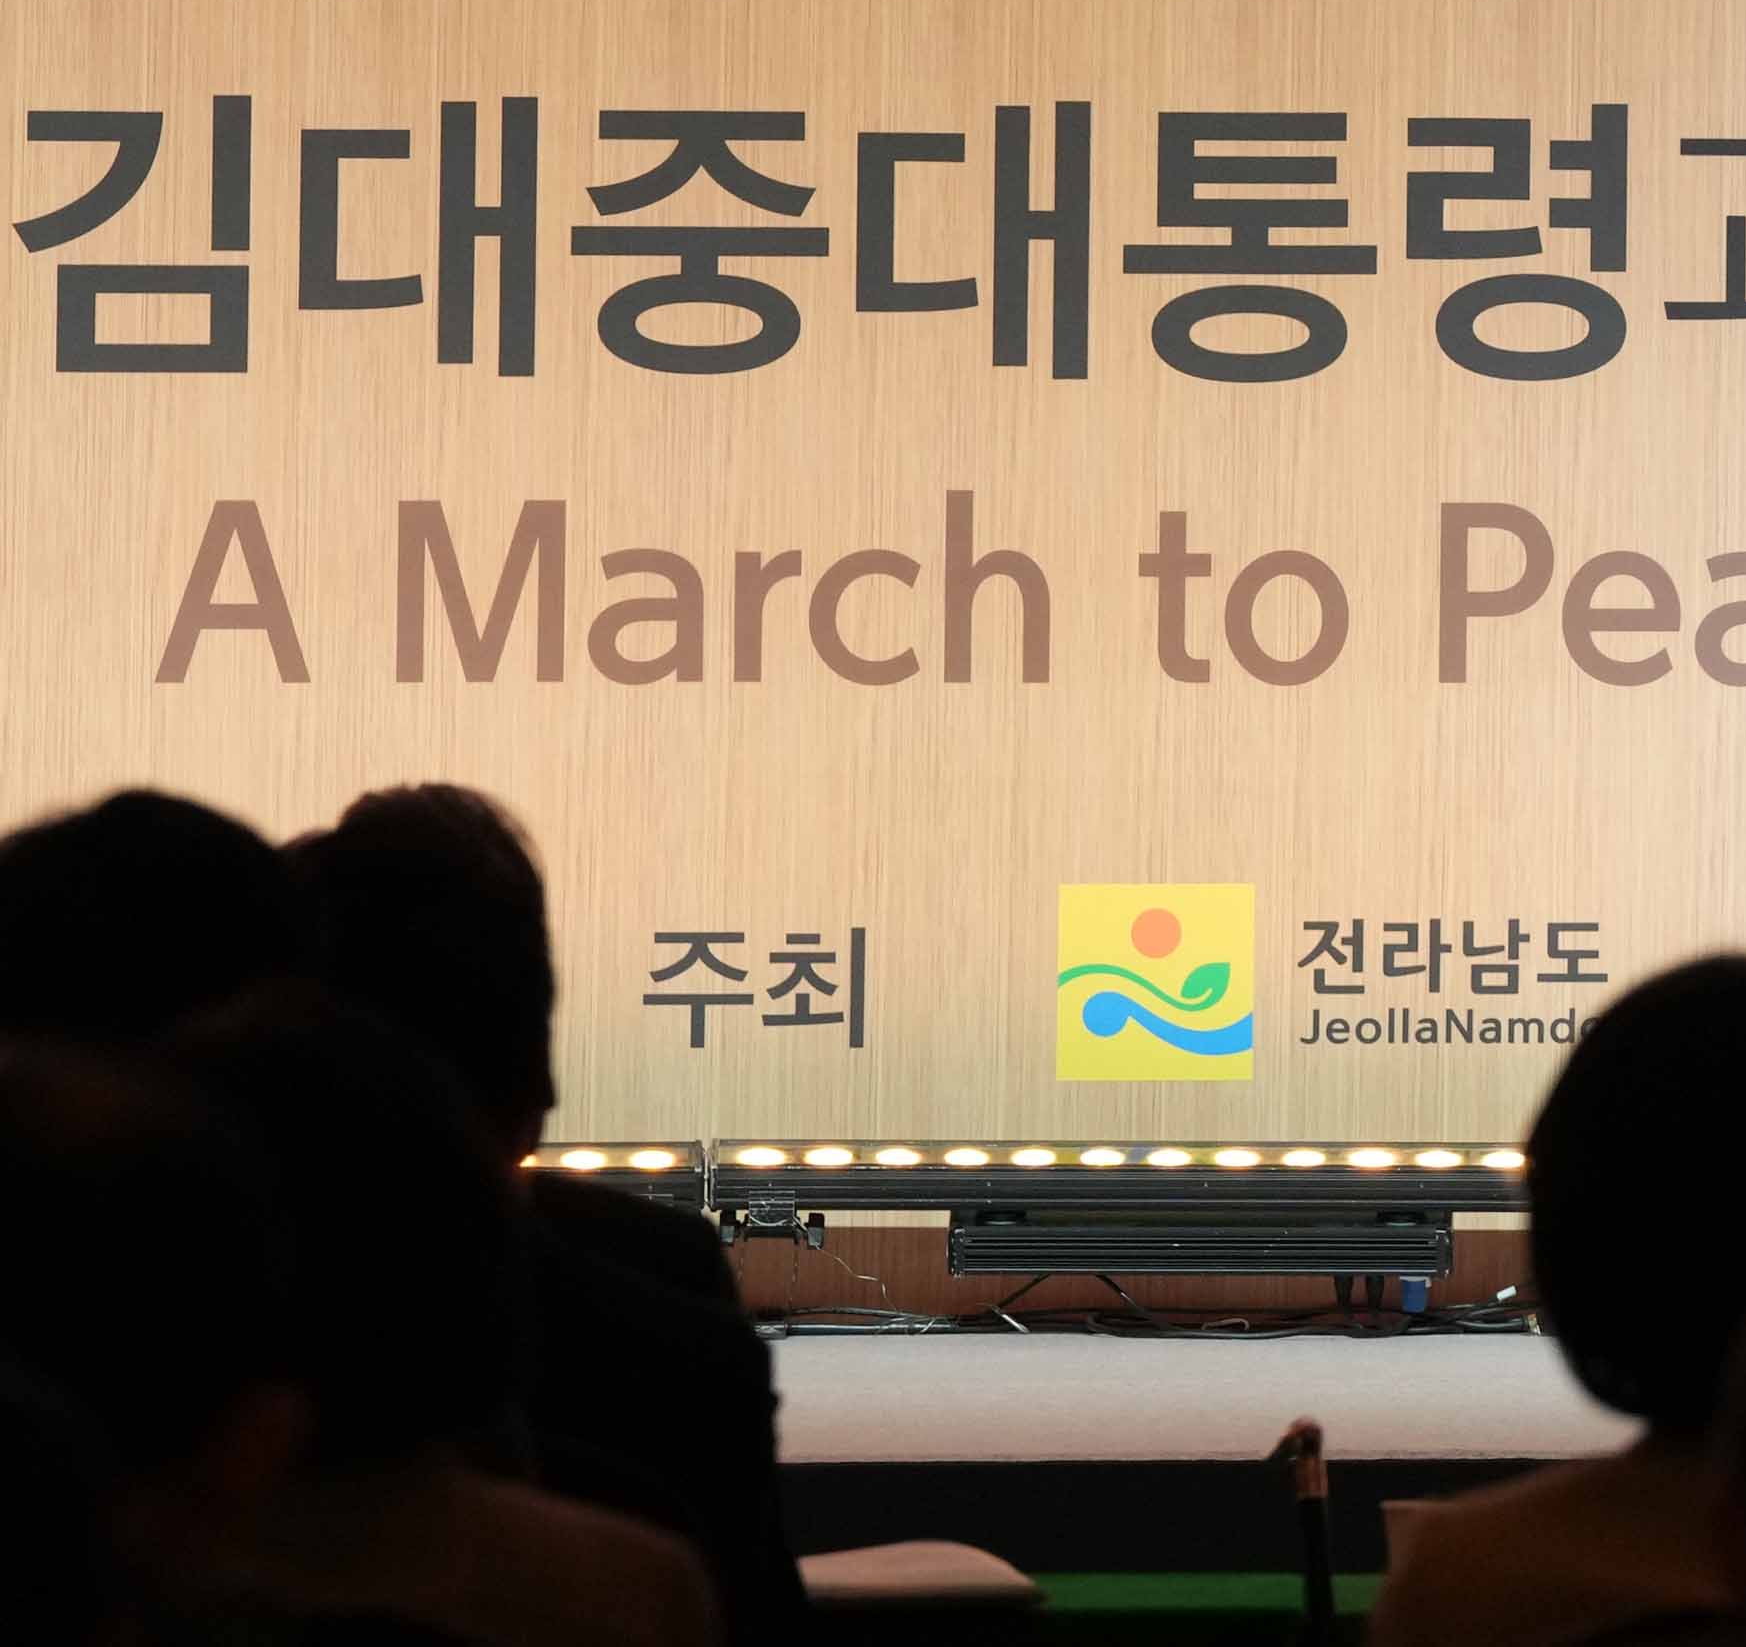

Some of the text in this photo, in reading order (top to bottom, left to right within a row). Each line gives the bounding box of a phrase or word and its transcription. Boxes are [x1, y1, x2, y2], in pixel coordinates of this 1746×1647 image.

[154, 499, 312, 685] A
[396, 489, 1052, 687] March
[1138, 510, 1351, 688] to
[642, 925, 868, 1049] 주최
[1297, 918, 1608, 994] 전라남도
